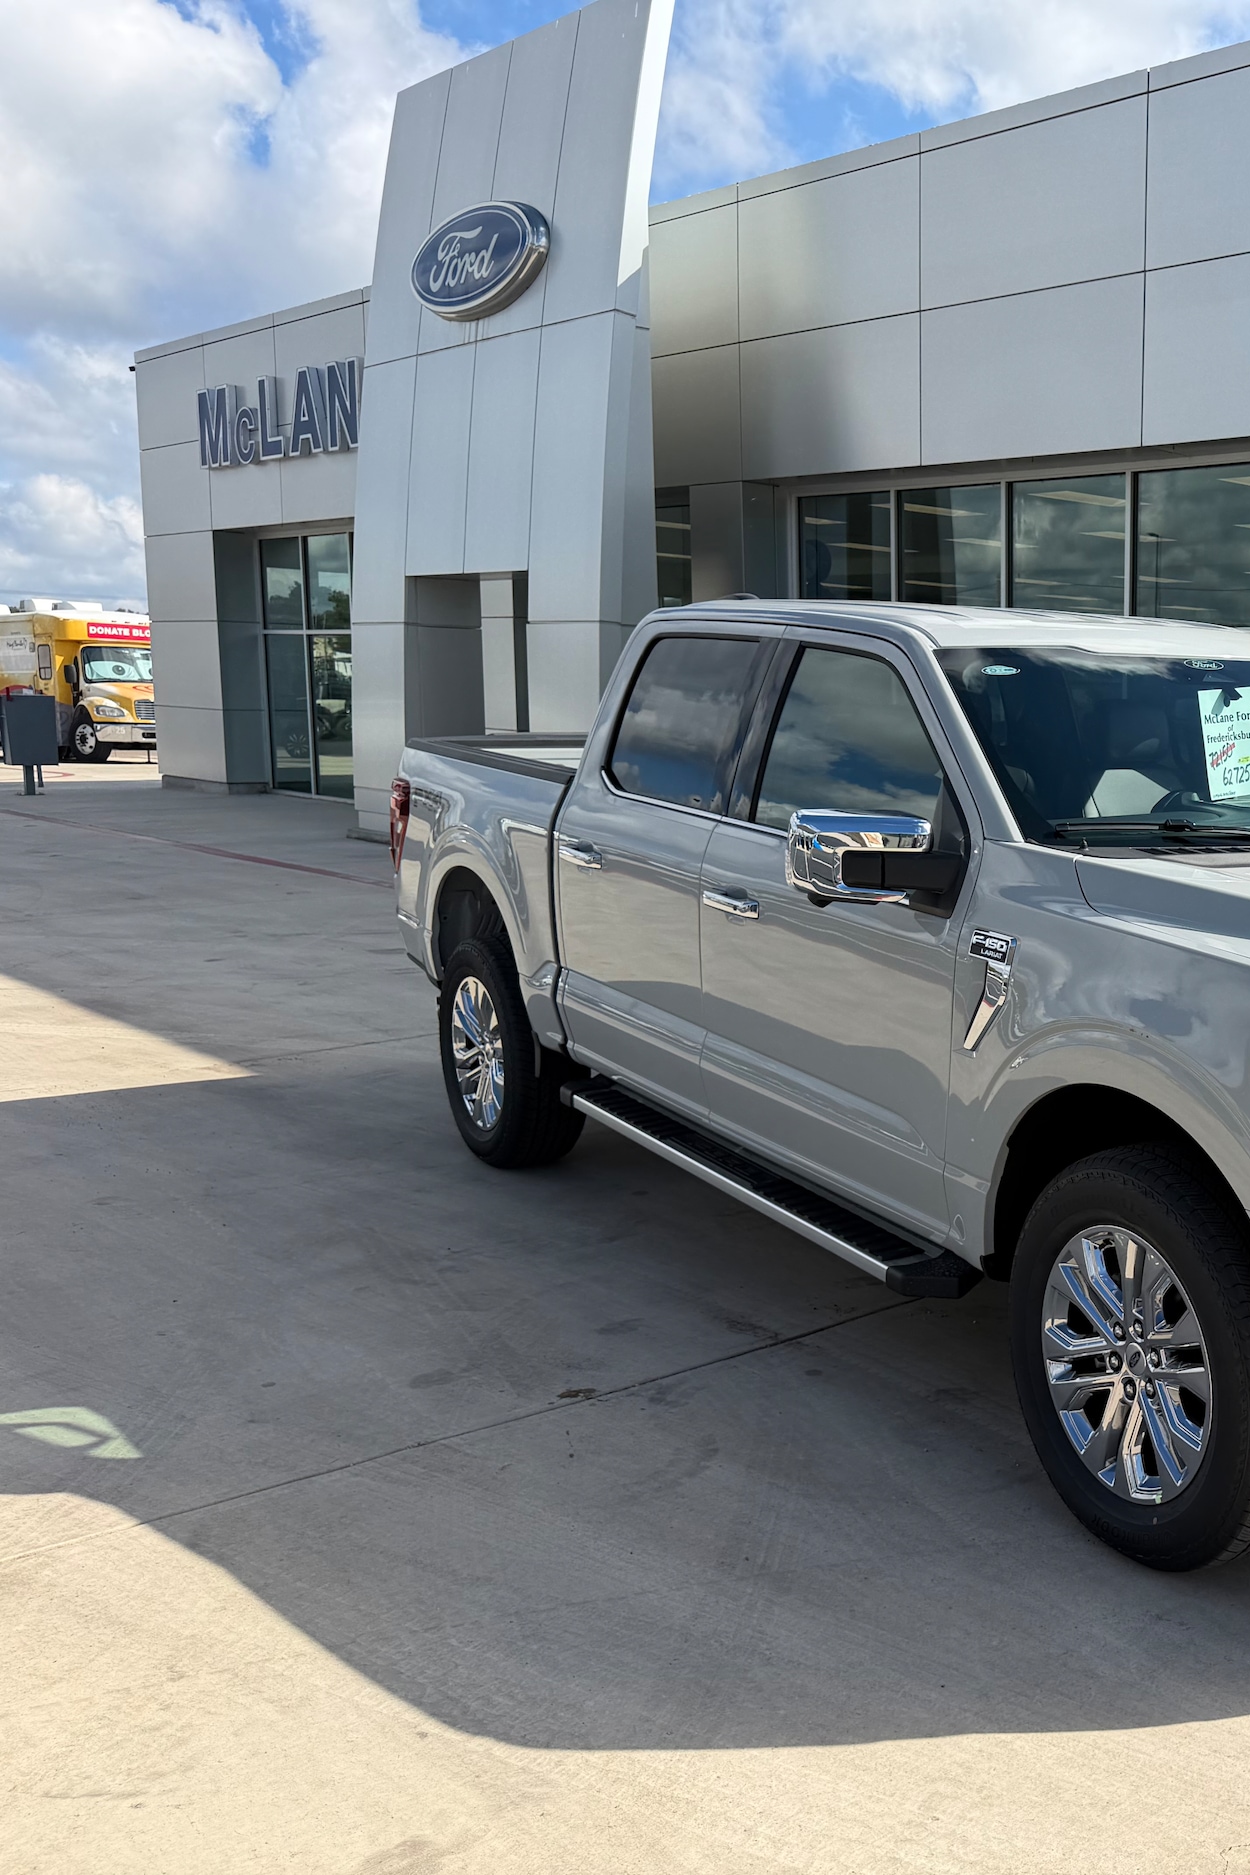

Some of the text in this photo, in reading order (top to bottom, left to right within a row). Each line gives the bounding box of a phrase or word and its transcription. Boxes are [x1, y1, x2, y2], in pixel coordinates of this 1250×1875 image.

[429, 225, 499, 293] Ford
[89, 626, 130, 636] DONATE
[1204, 713, 1234, 725] McLane
[1227, 724, 1234, 732] of
[1223, 763, 1250, 786] 62725
[972, 935, 1008, 953] F-150
[980, 948, 1003, 959] LARIAT
